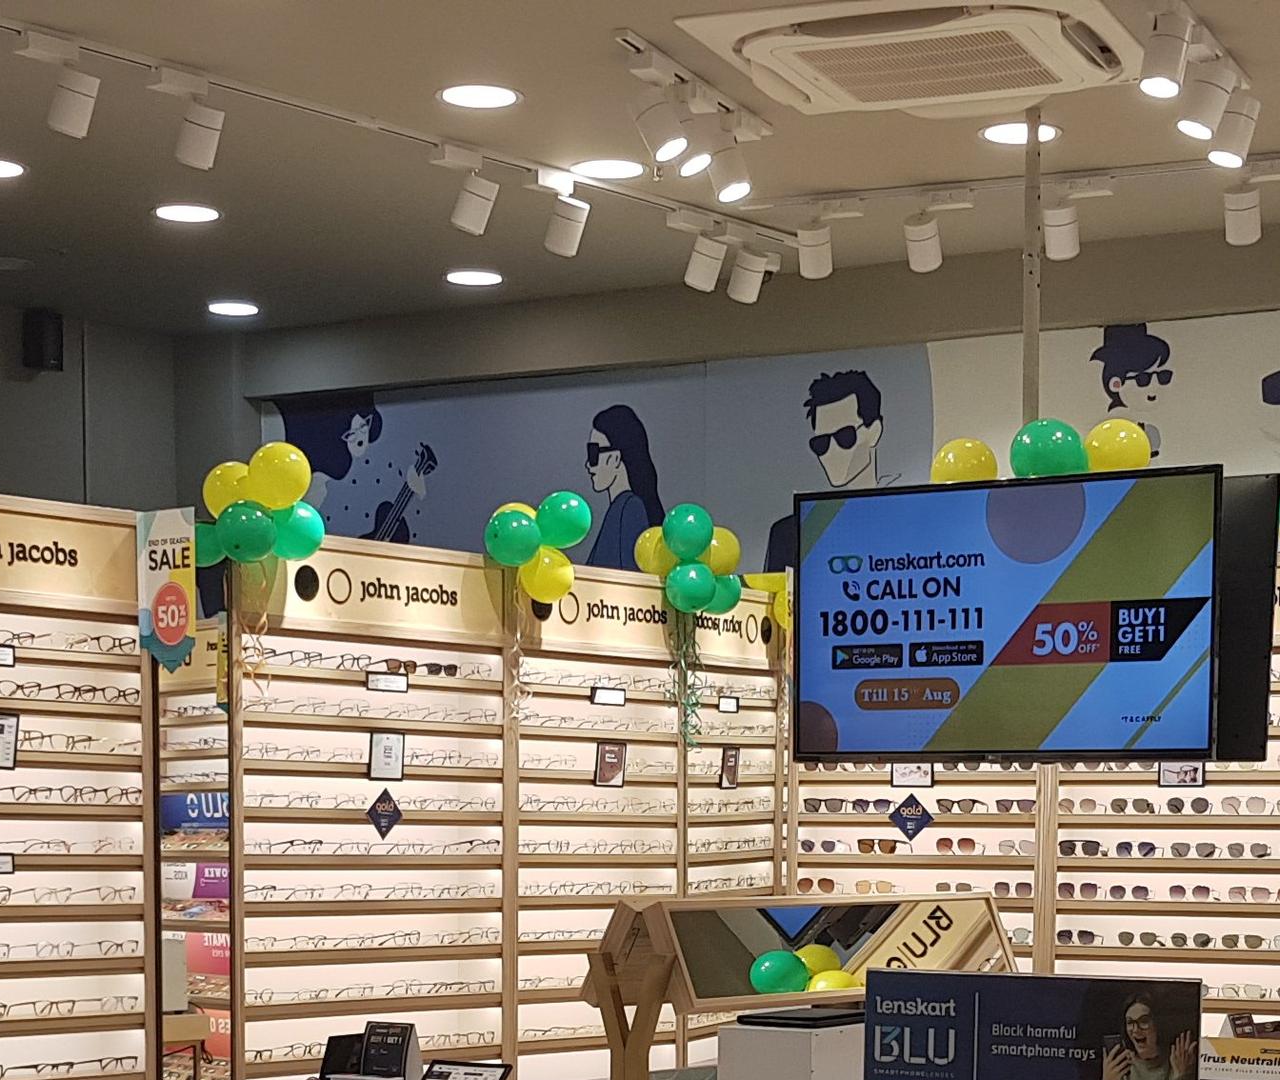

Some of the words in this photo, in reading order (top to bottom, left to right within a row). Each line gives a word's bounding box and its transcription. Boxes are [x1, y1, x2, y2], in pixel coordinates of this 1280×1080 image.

[148, 539, 160, 547] END
[7, 541, 78, 567] jacobs
[148, 547, 191, 571] SALE
[868, 551, 985, 572] lenskart.com
[360, 577, 401, 602] john
[404, 583, 458, 606] jacobs
[866, 578, 918, 600] CALL
[922, 576, 961, 598] ON
[586, 597, 620, 619] john
[624, 602, 667, 625] jacobs
[820, 607, 983, 636] 1800-111-111
[853, 655, 881, 666] Google
[882, 654, 899, 665] Play
[931, 653, 951, 664] App
[953, 652, 977, 662] Store
[1118, 645, 1141, 654] FREE
[861, 688, 888, 701] Till
[922, 687, 952, 703] Aug
[900, 804, 923, 817] gold
[876, 996, 956, 1017] lenskart
[992, 1023, 1023, 1037] Block
[1026, 1024, 1076, 1040] harmful
[874, 1025, 955, 1066] BLU
[991, 1043, 1065, 1059] smartphone
[1069, 1048, 1096, 1062] rays
